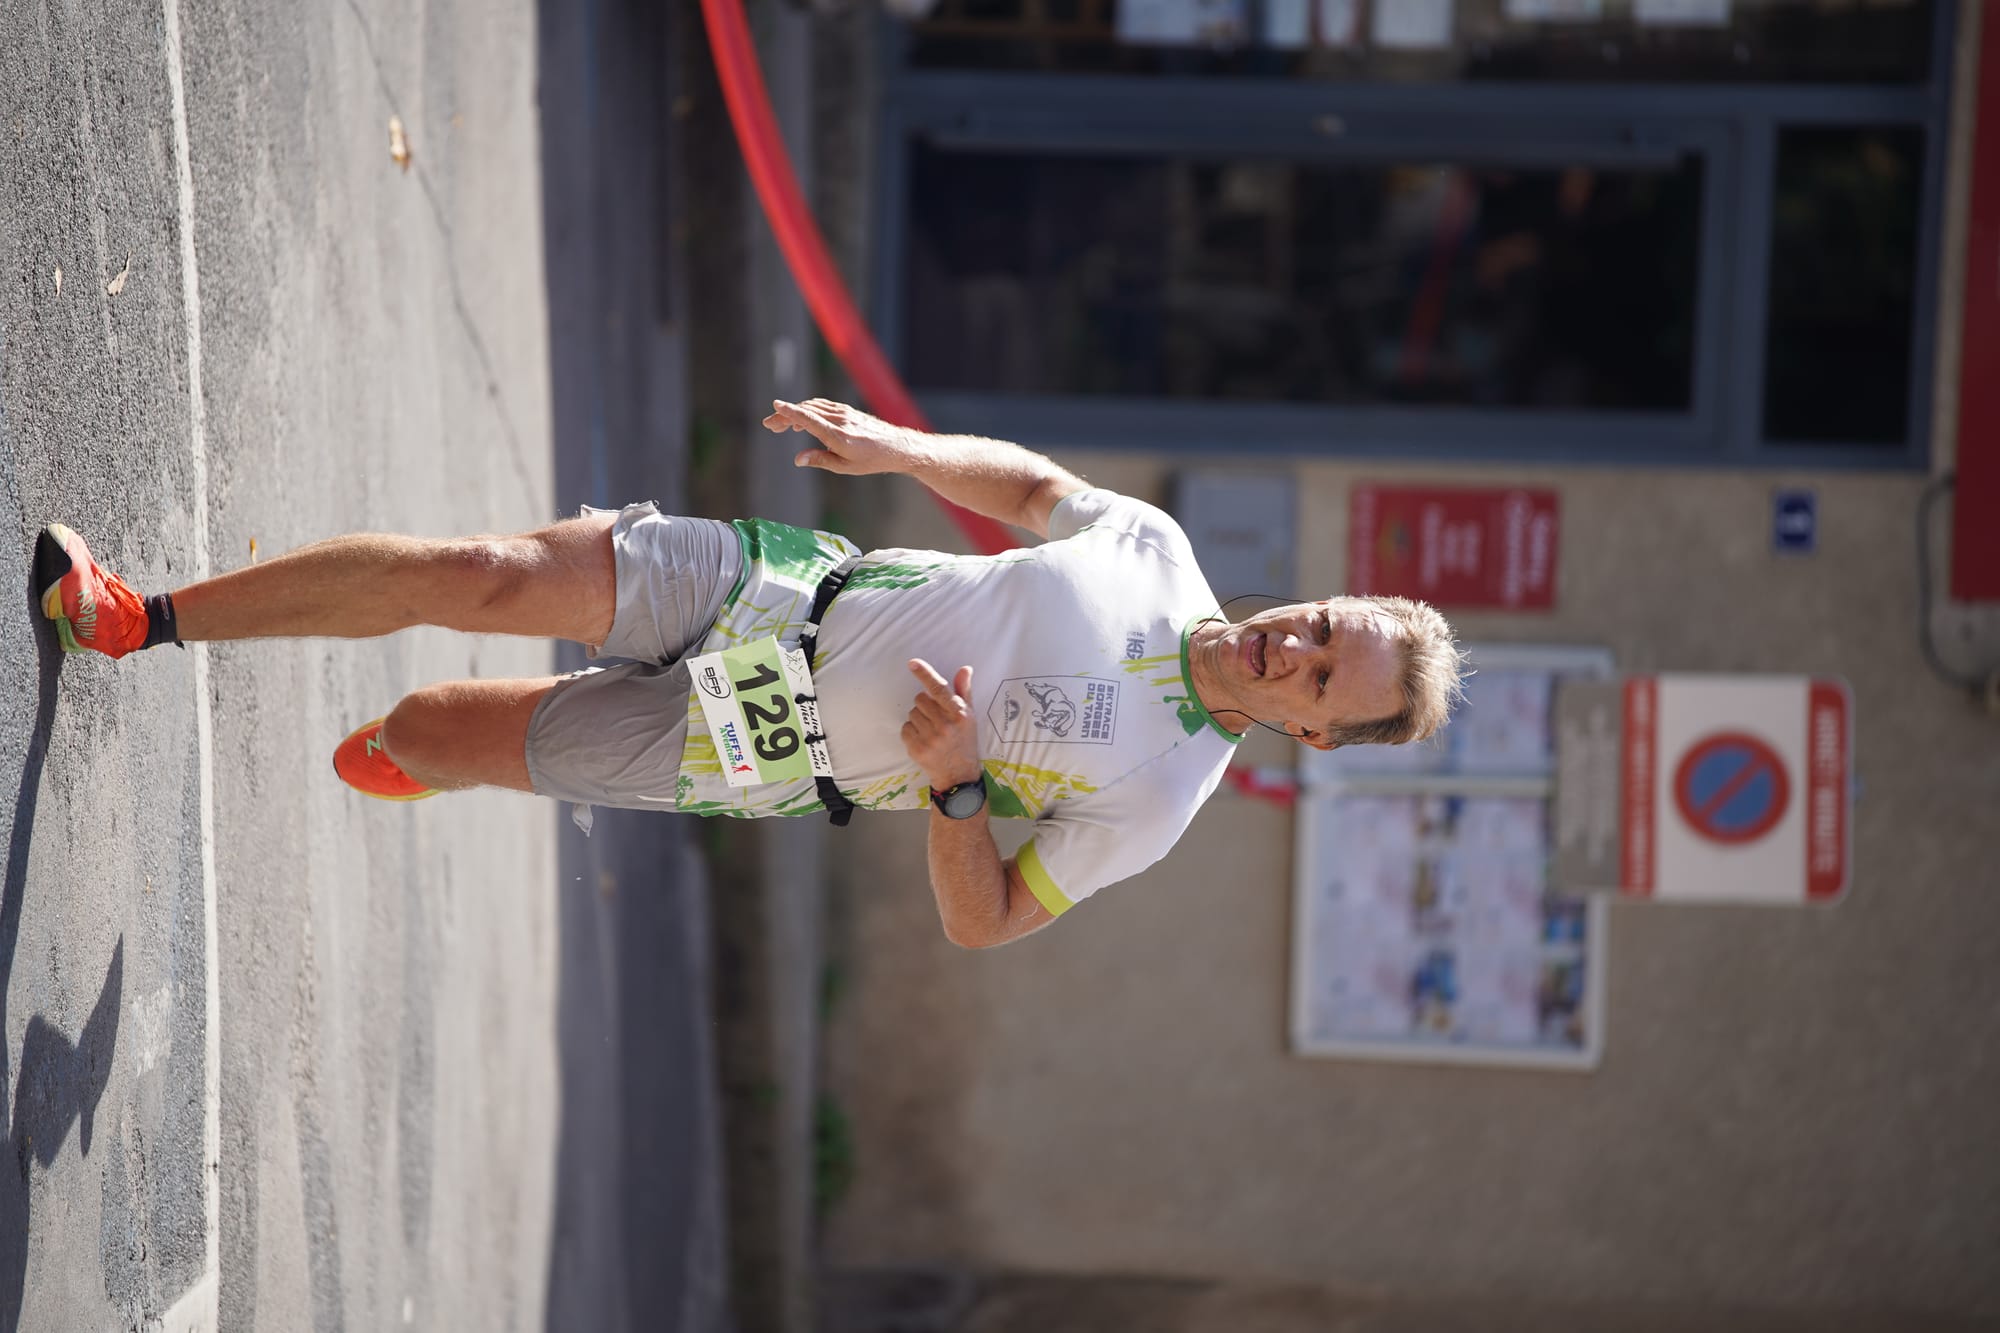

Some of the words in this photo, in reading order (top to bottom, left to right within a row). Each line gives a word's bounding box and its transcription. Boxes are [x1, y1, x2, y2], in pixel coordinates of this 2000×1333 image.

[74, 589, 97, 641] KIPRUN
[704, 667, 721, 694] BFP
[1086, 684, 1095, 700] DU
[735, 663, 799, 762] 129
[807, 700, 820, 744] Challene
[1080, 704, 1093, 738] TARN
[1091, 684, 1105, 738] GORGES
[1101, 685, 1114, 739] SKYRACE
[719, 727, 738, 766] Aventure
[724, 722, 743, 761] TUFF'S
